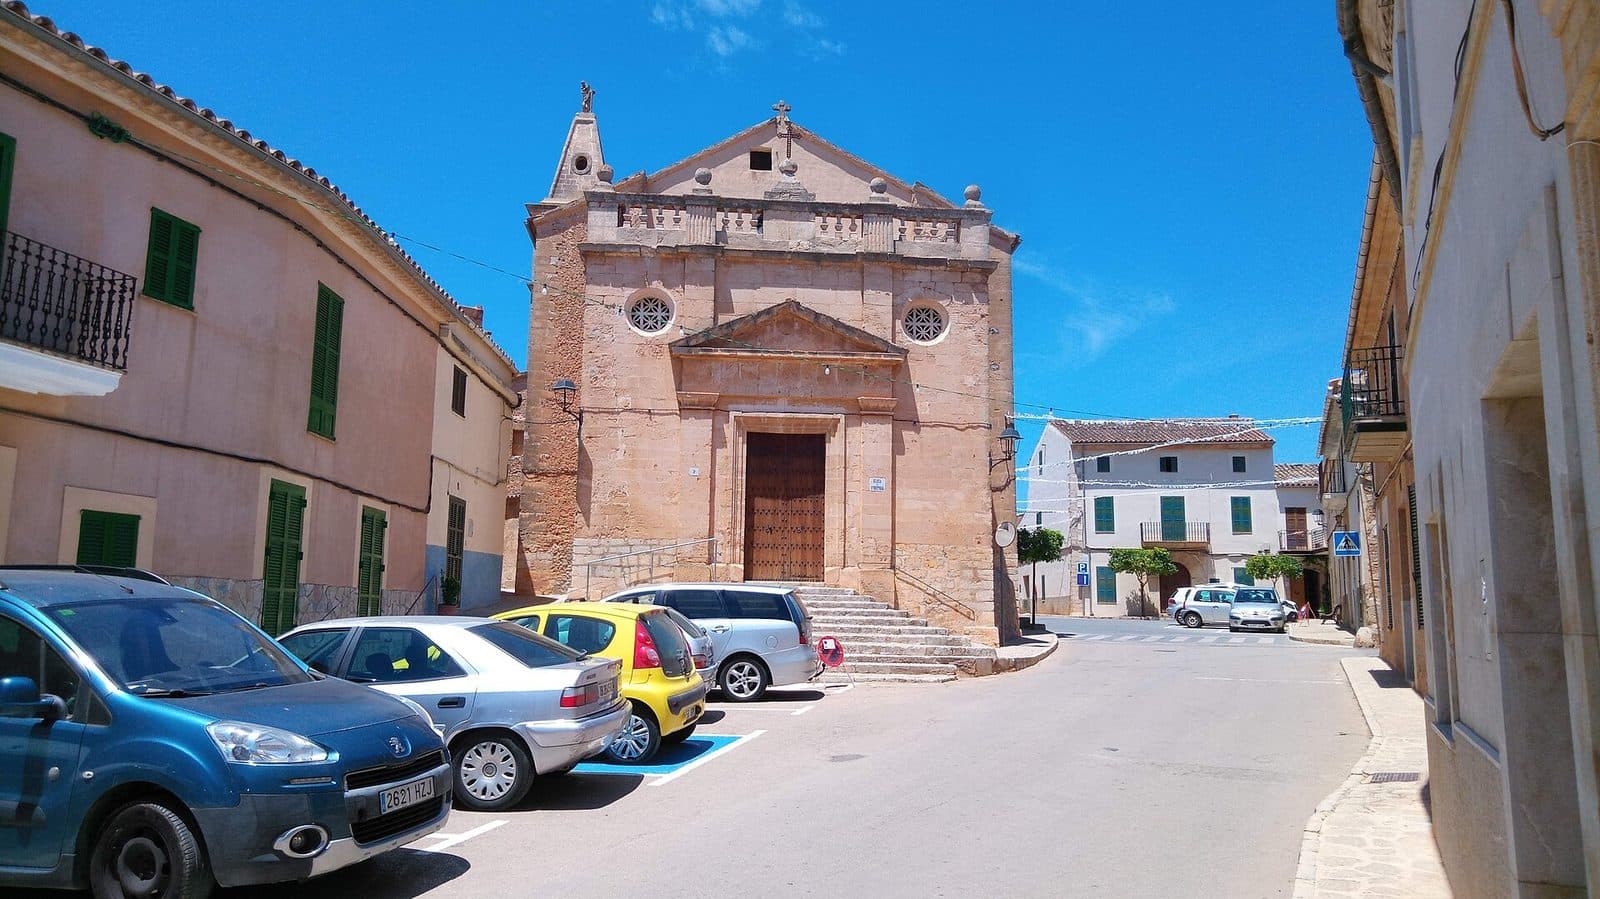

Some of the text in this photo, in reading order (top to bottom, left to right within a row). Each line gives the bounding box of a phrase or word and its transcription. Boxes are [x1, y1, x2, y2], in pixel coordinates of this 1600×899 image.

[1079, 563, 1086, 572] P
[387, 779, 432, 809] 2621 HZJ
